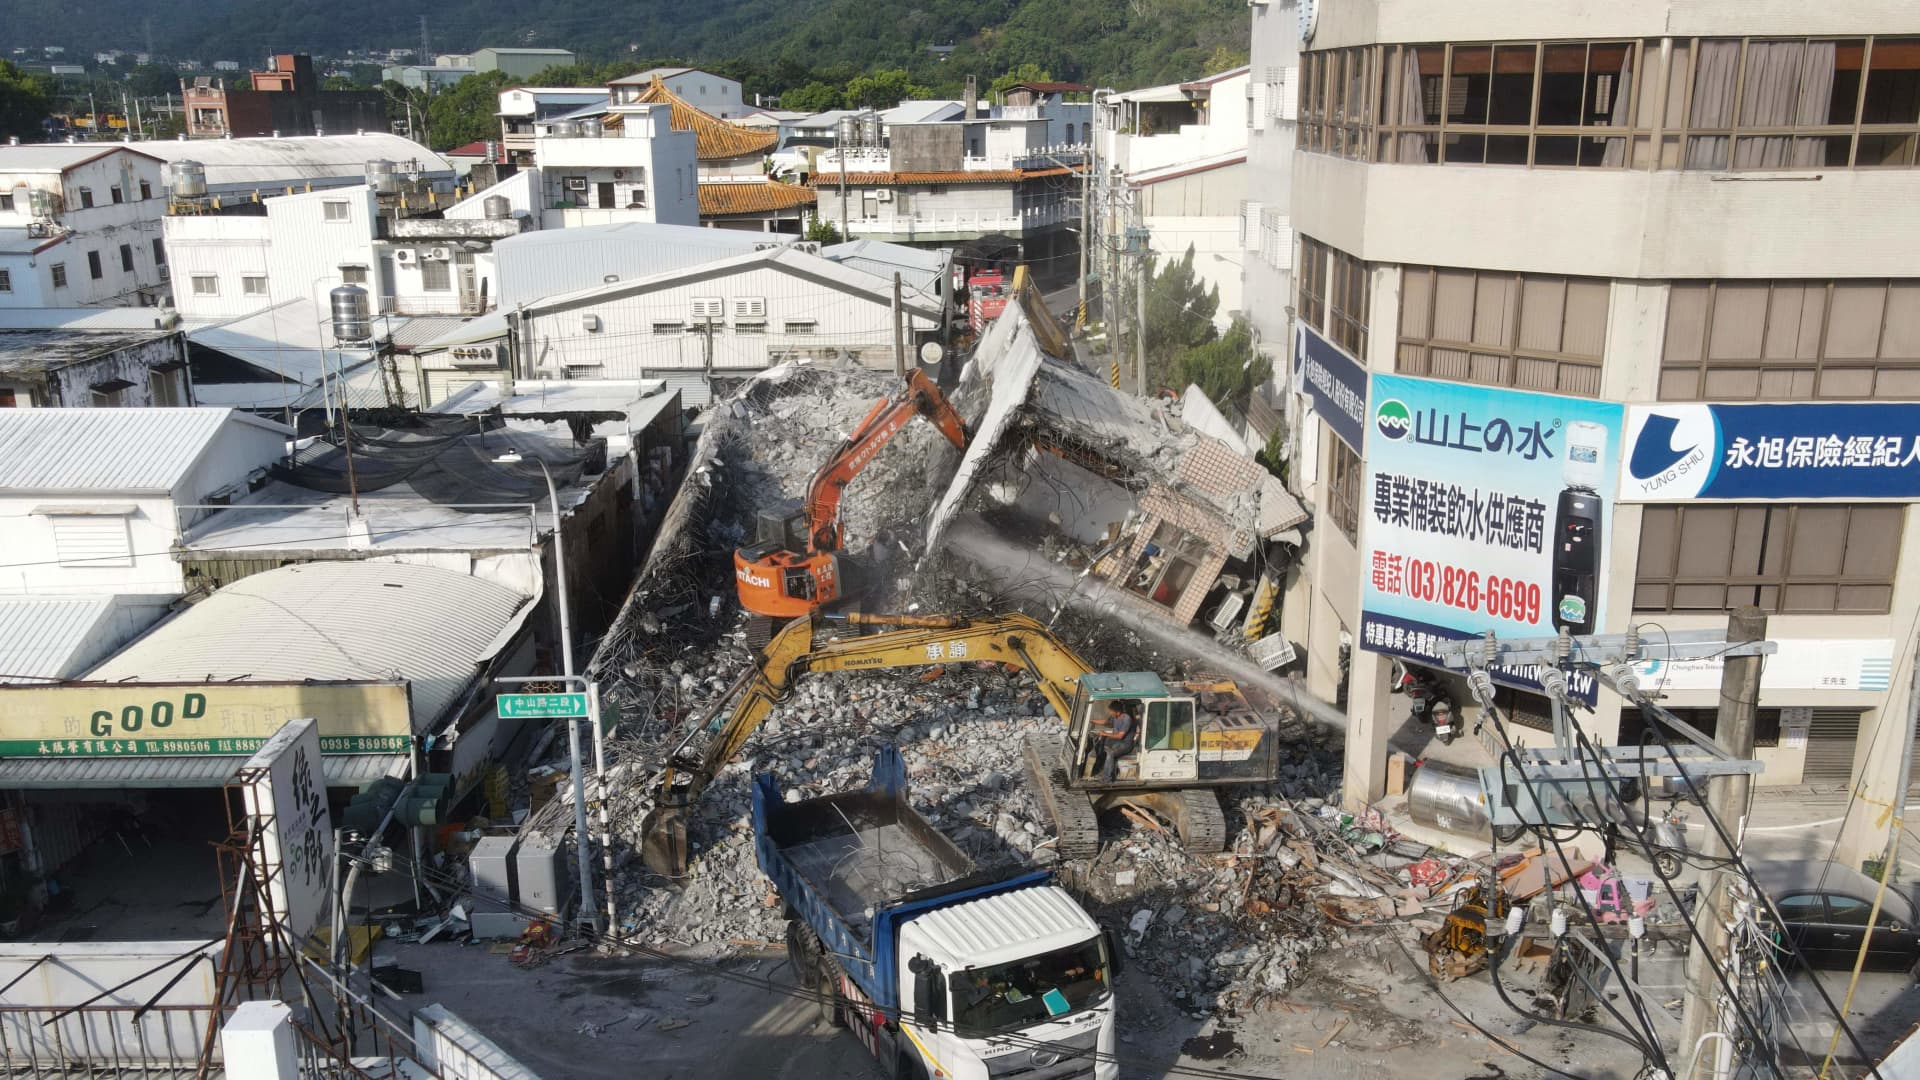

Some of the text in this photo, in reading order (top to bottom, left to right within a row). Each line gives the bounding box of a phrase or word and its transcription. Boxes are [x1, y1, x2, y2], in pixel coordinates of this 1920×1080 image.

[1416, 408, 1554, 460] 山上の水
[1725, 434, 1920, 468] 永旭保險經紀人
[1641, 449, 1705, 494] YUNG SHIU
[1374, 472, 1546, 554] 專業桶裝飲水供應商
[845, 657, 883, 667] KOMATSU
[1822, 677, 1847, 685] 王先生
[90, 693, 207, 737] GOOD
[1083, 1018, 1102, 1029] 700
[985, 1045, 1013, 1055] HINO
